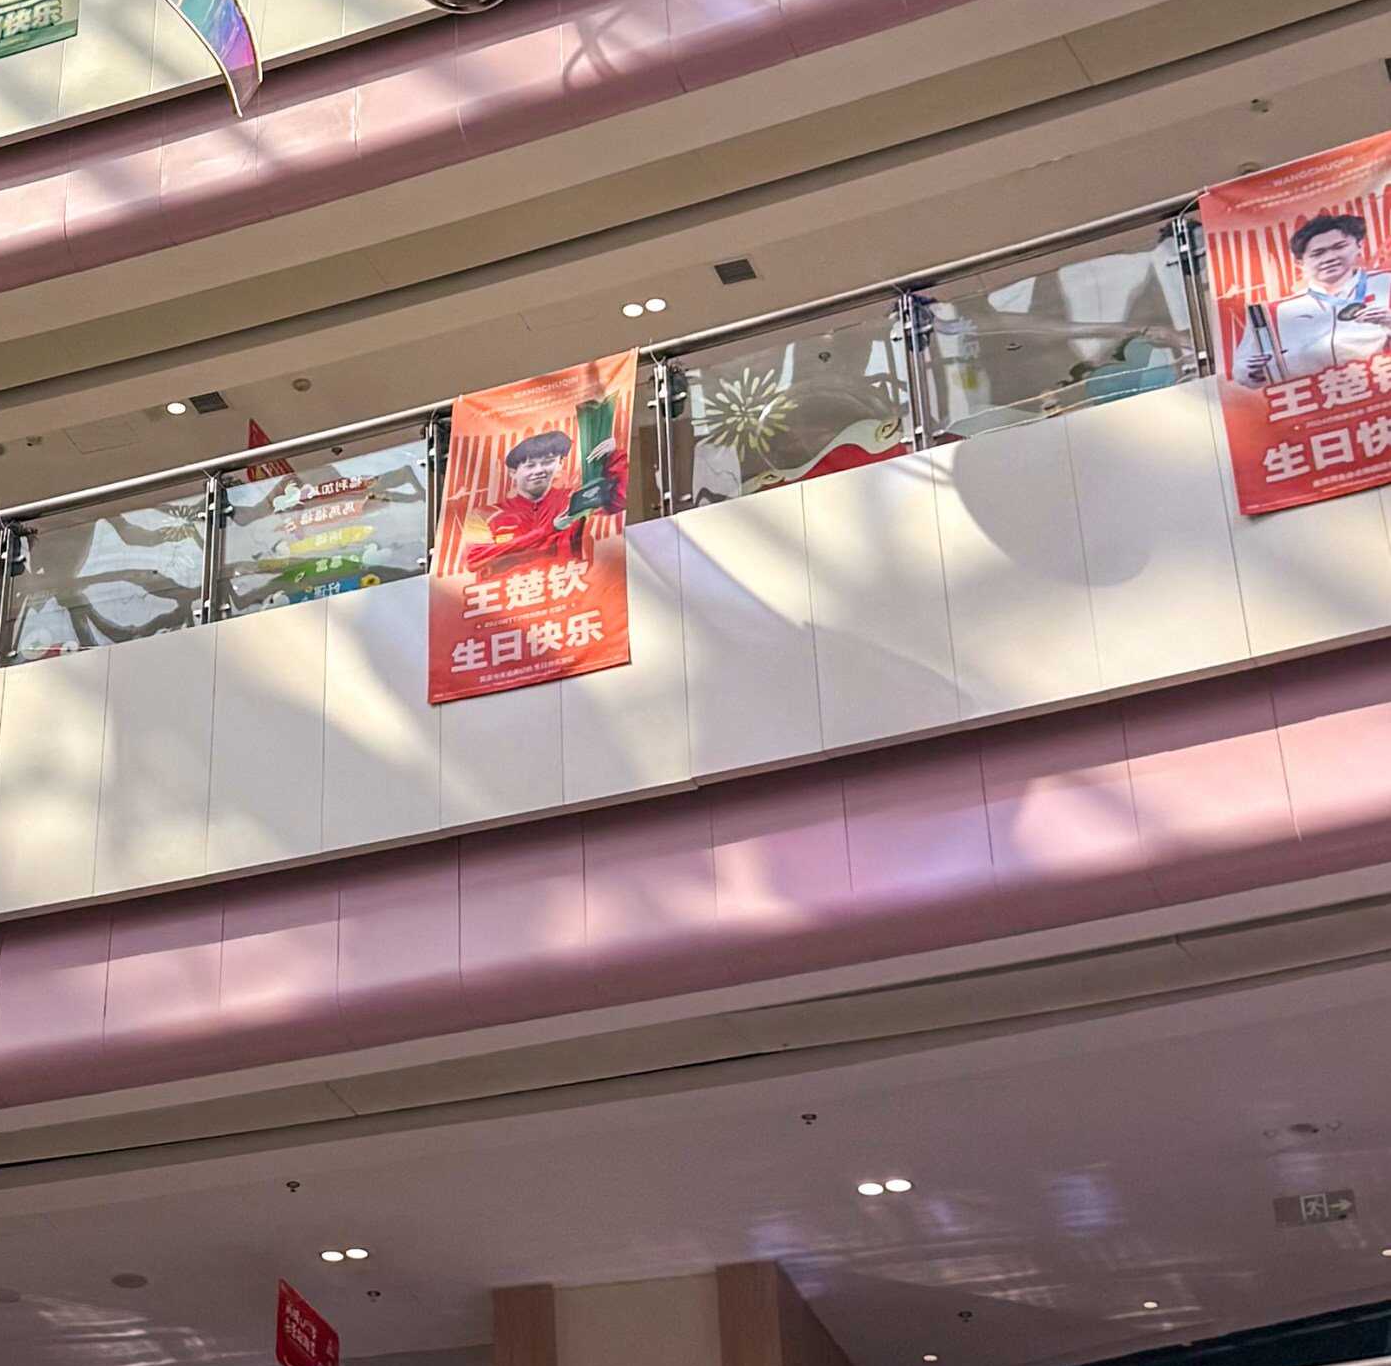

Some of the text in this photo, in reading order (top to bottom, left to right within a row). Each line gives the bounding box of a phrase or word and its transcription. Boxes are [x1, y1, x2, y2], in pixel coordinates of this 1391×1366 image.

[462, 558, 590, 620] 王楚钦
[450, 609, 605, 674] 生日快乐
